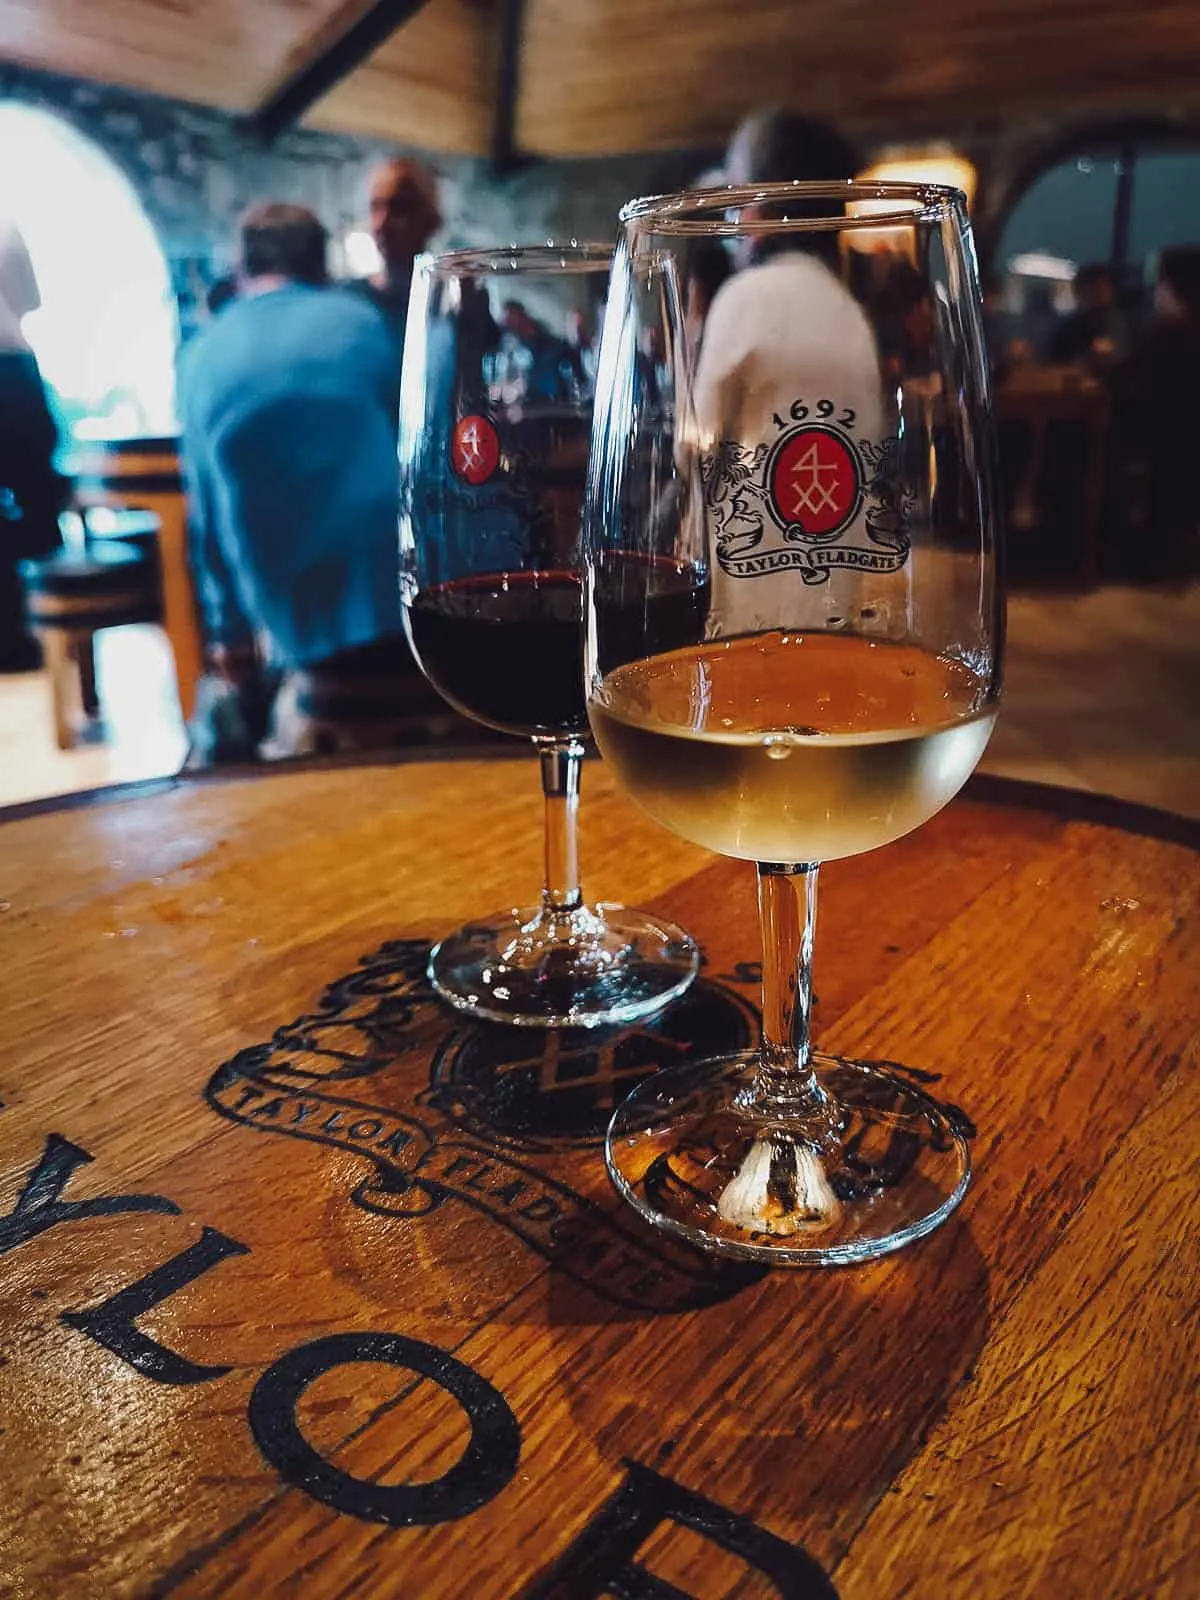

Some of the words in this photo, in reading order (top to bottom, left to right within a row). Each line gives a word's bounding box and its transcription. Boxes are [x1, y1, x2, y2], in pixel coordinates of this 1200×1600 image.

[772, 399, 857, 431] 1692
[734, 554, 802, 575] TAYLOR
[817, 549, 896, 570] FLADGATE
[233, 1085, 414, 1157] TAYLOR
